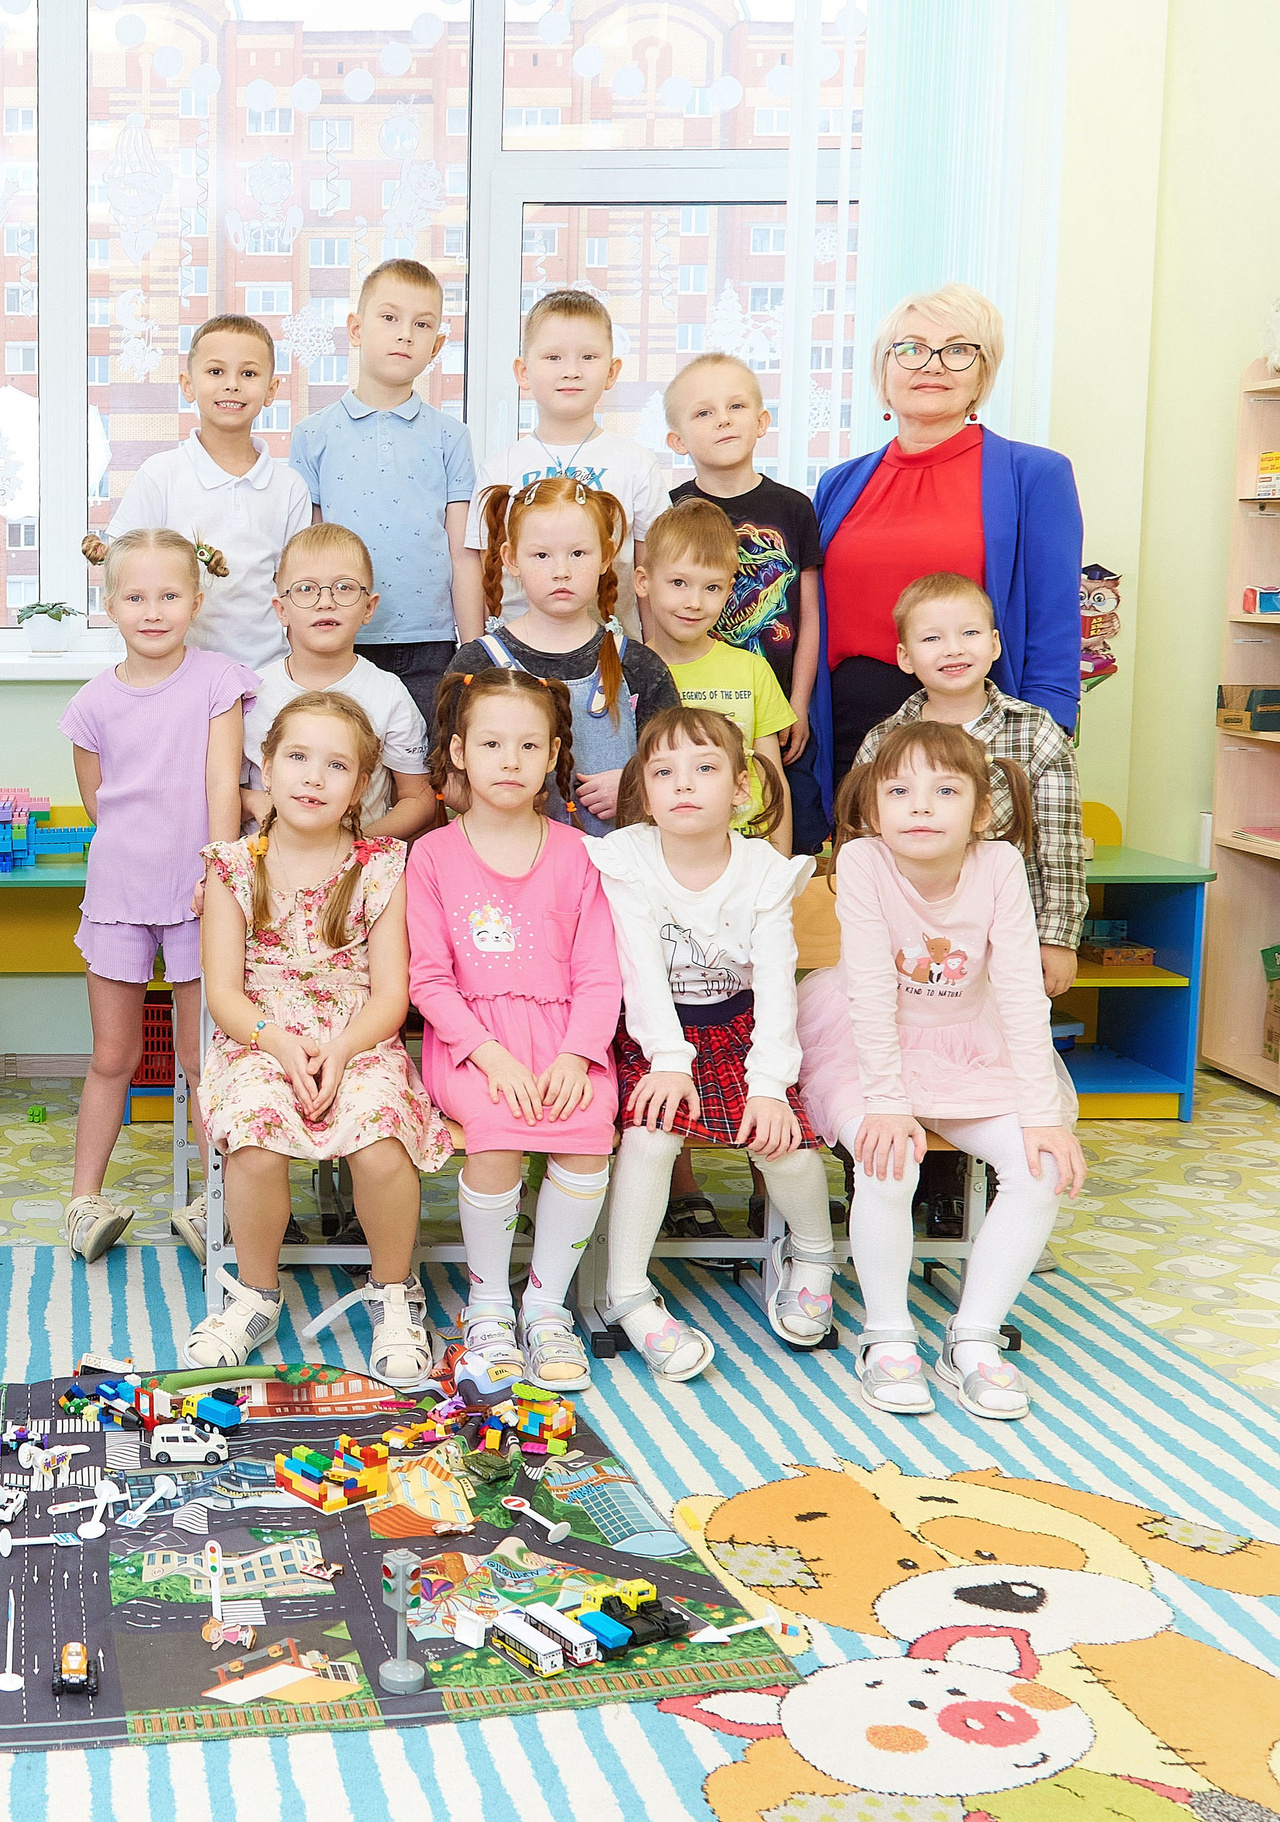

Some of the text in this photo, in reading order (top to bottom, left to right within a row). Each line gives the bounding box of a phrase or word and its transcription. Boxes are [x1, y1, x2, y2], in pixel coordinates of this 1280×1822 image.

[680, 690, 752, 701] LEGENDS OF THE DEEP
[905, 986, 922, 995] KIND
[926, 989, 934, 997] TO
[938, 990, 963, 998] NATURE
